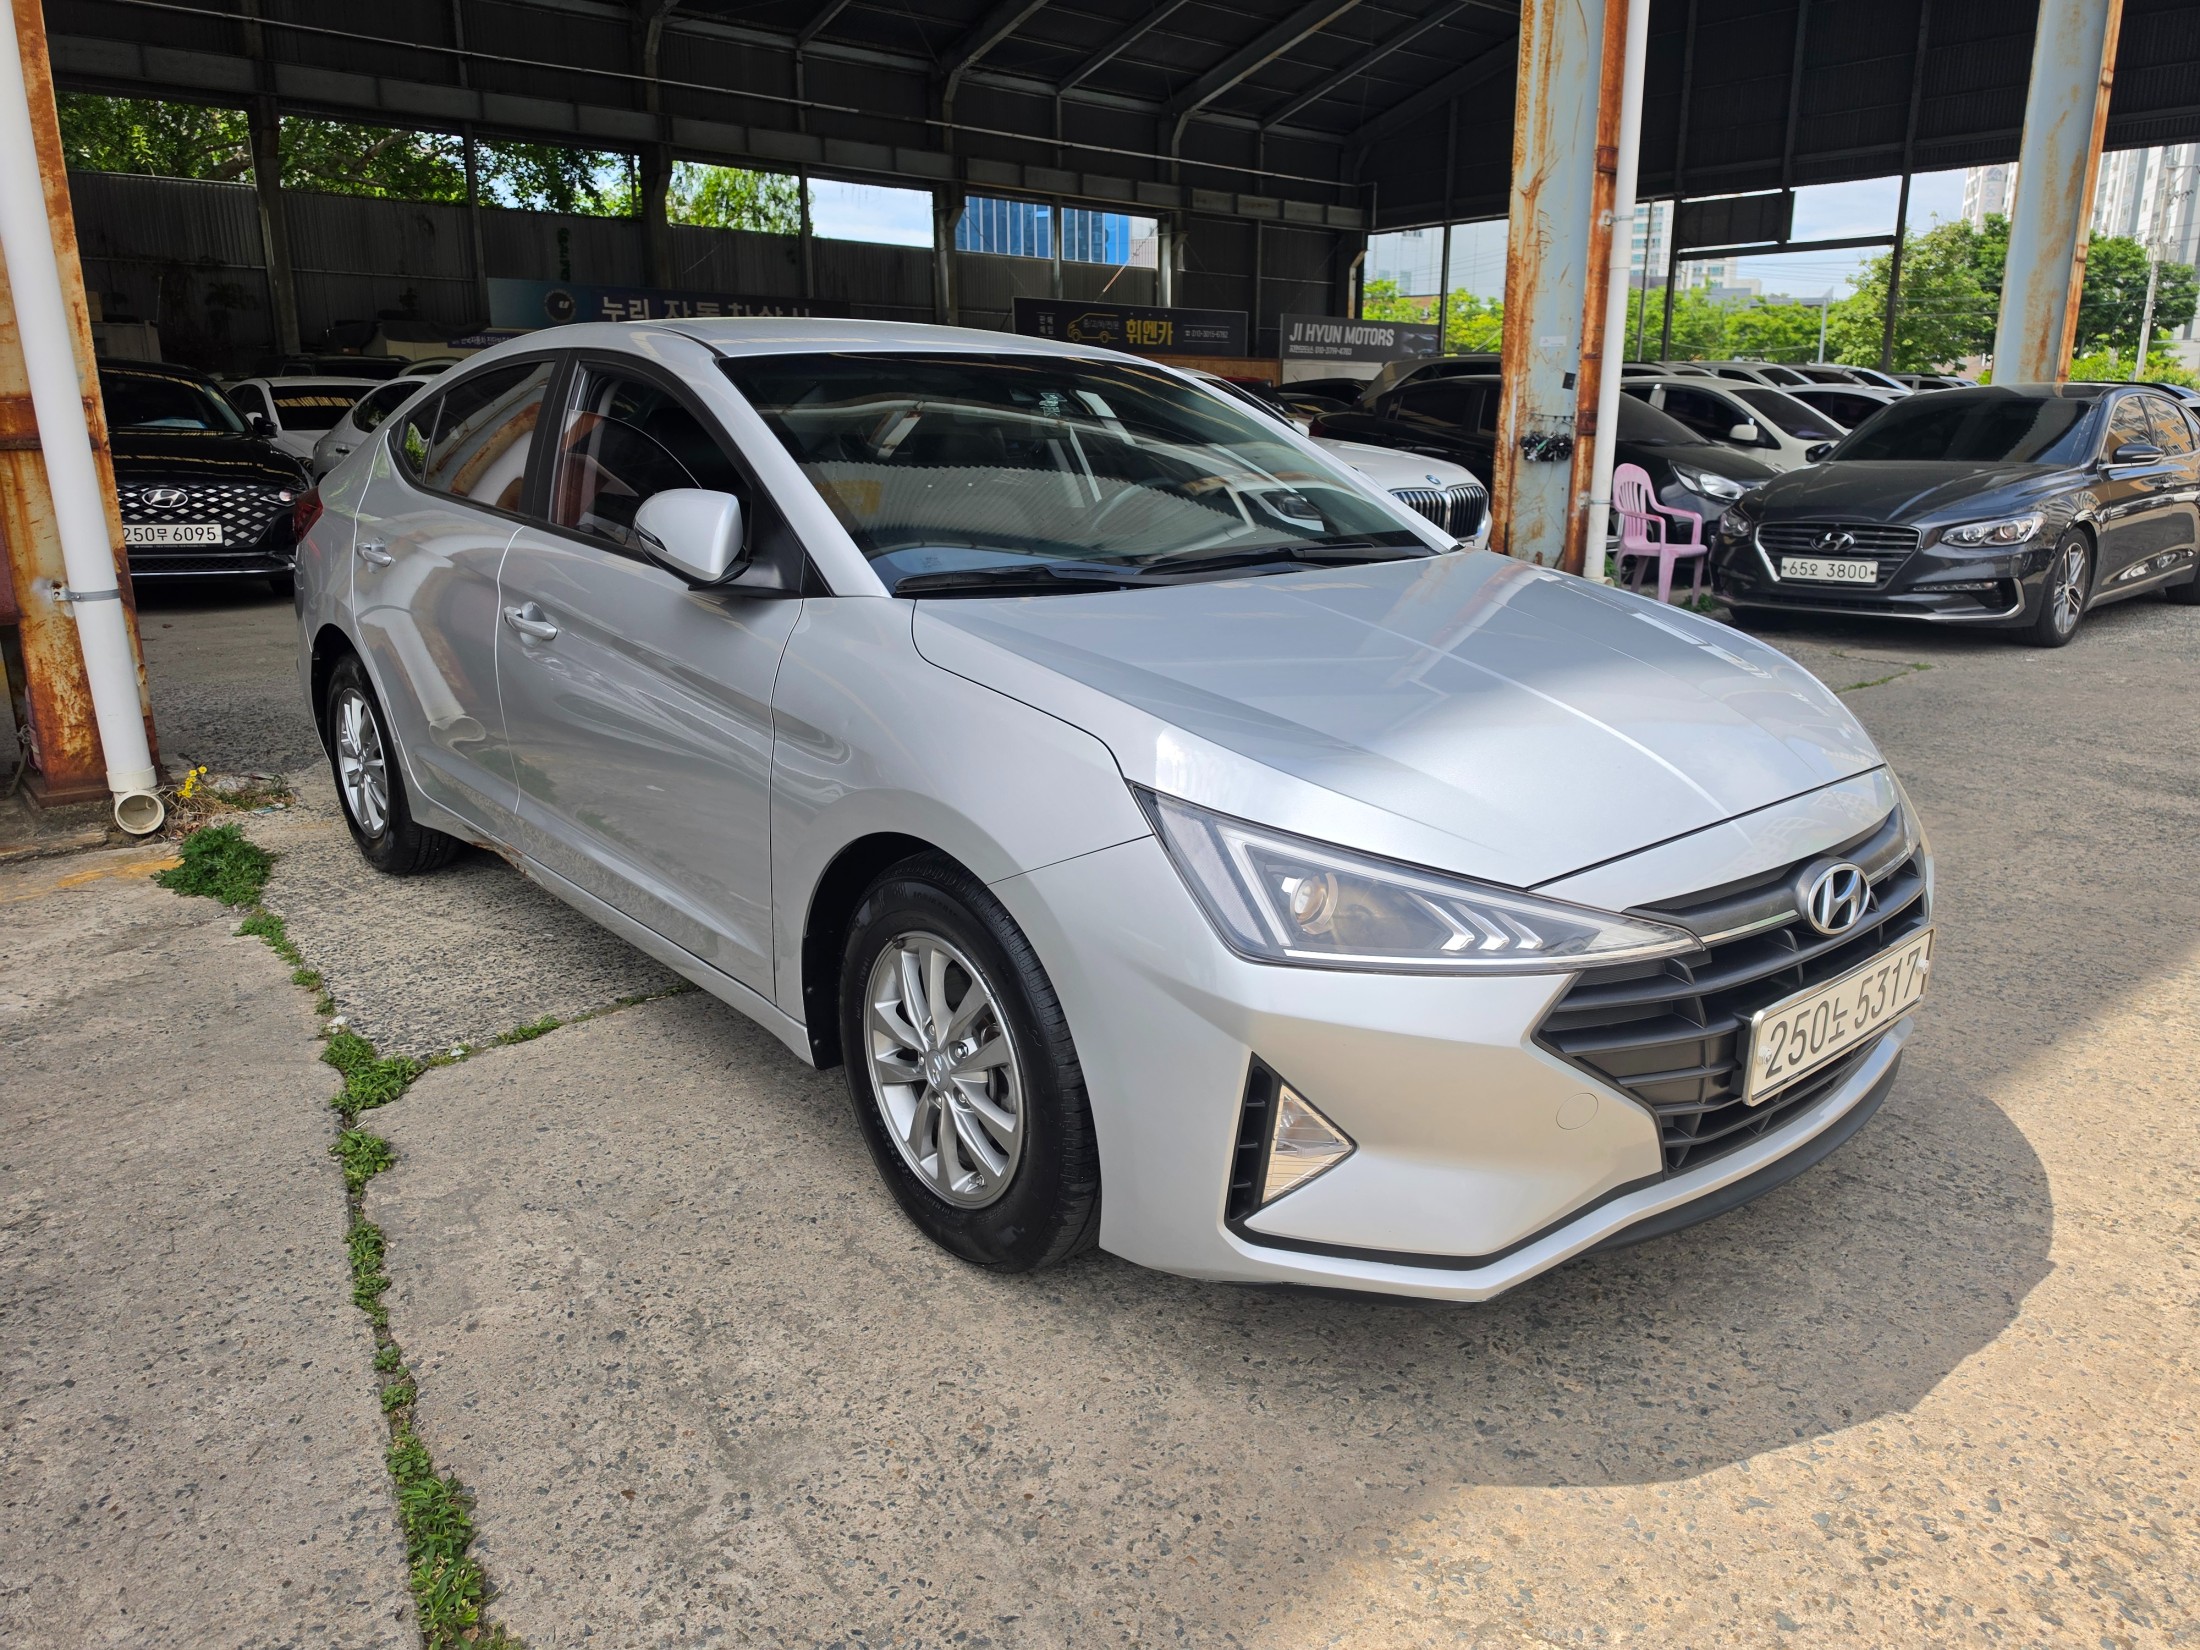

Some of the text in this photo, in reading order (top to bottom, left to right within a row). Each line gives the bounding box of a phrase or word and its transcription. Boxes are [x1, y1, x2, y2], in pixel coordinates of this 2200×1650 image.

[601, 296, 650, 322] 누리
[1125, 318, 1174, 346] 휘엔카
[1289, 323, 1394, 346] JI HYUN MOTORS
[123, 526, 216, 542] 250무 6095
[1789, 561, 1868, 579] 65오 3800
[1765, 946, 1922, 1080] 250노 5317
